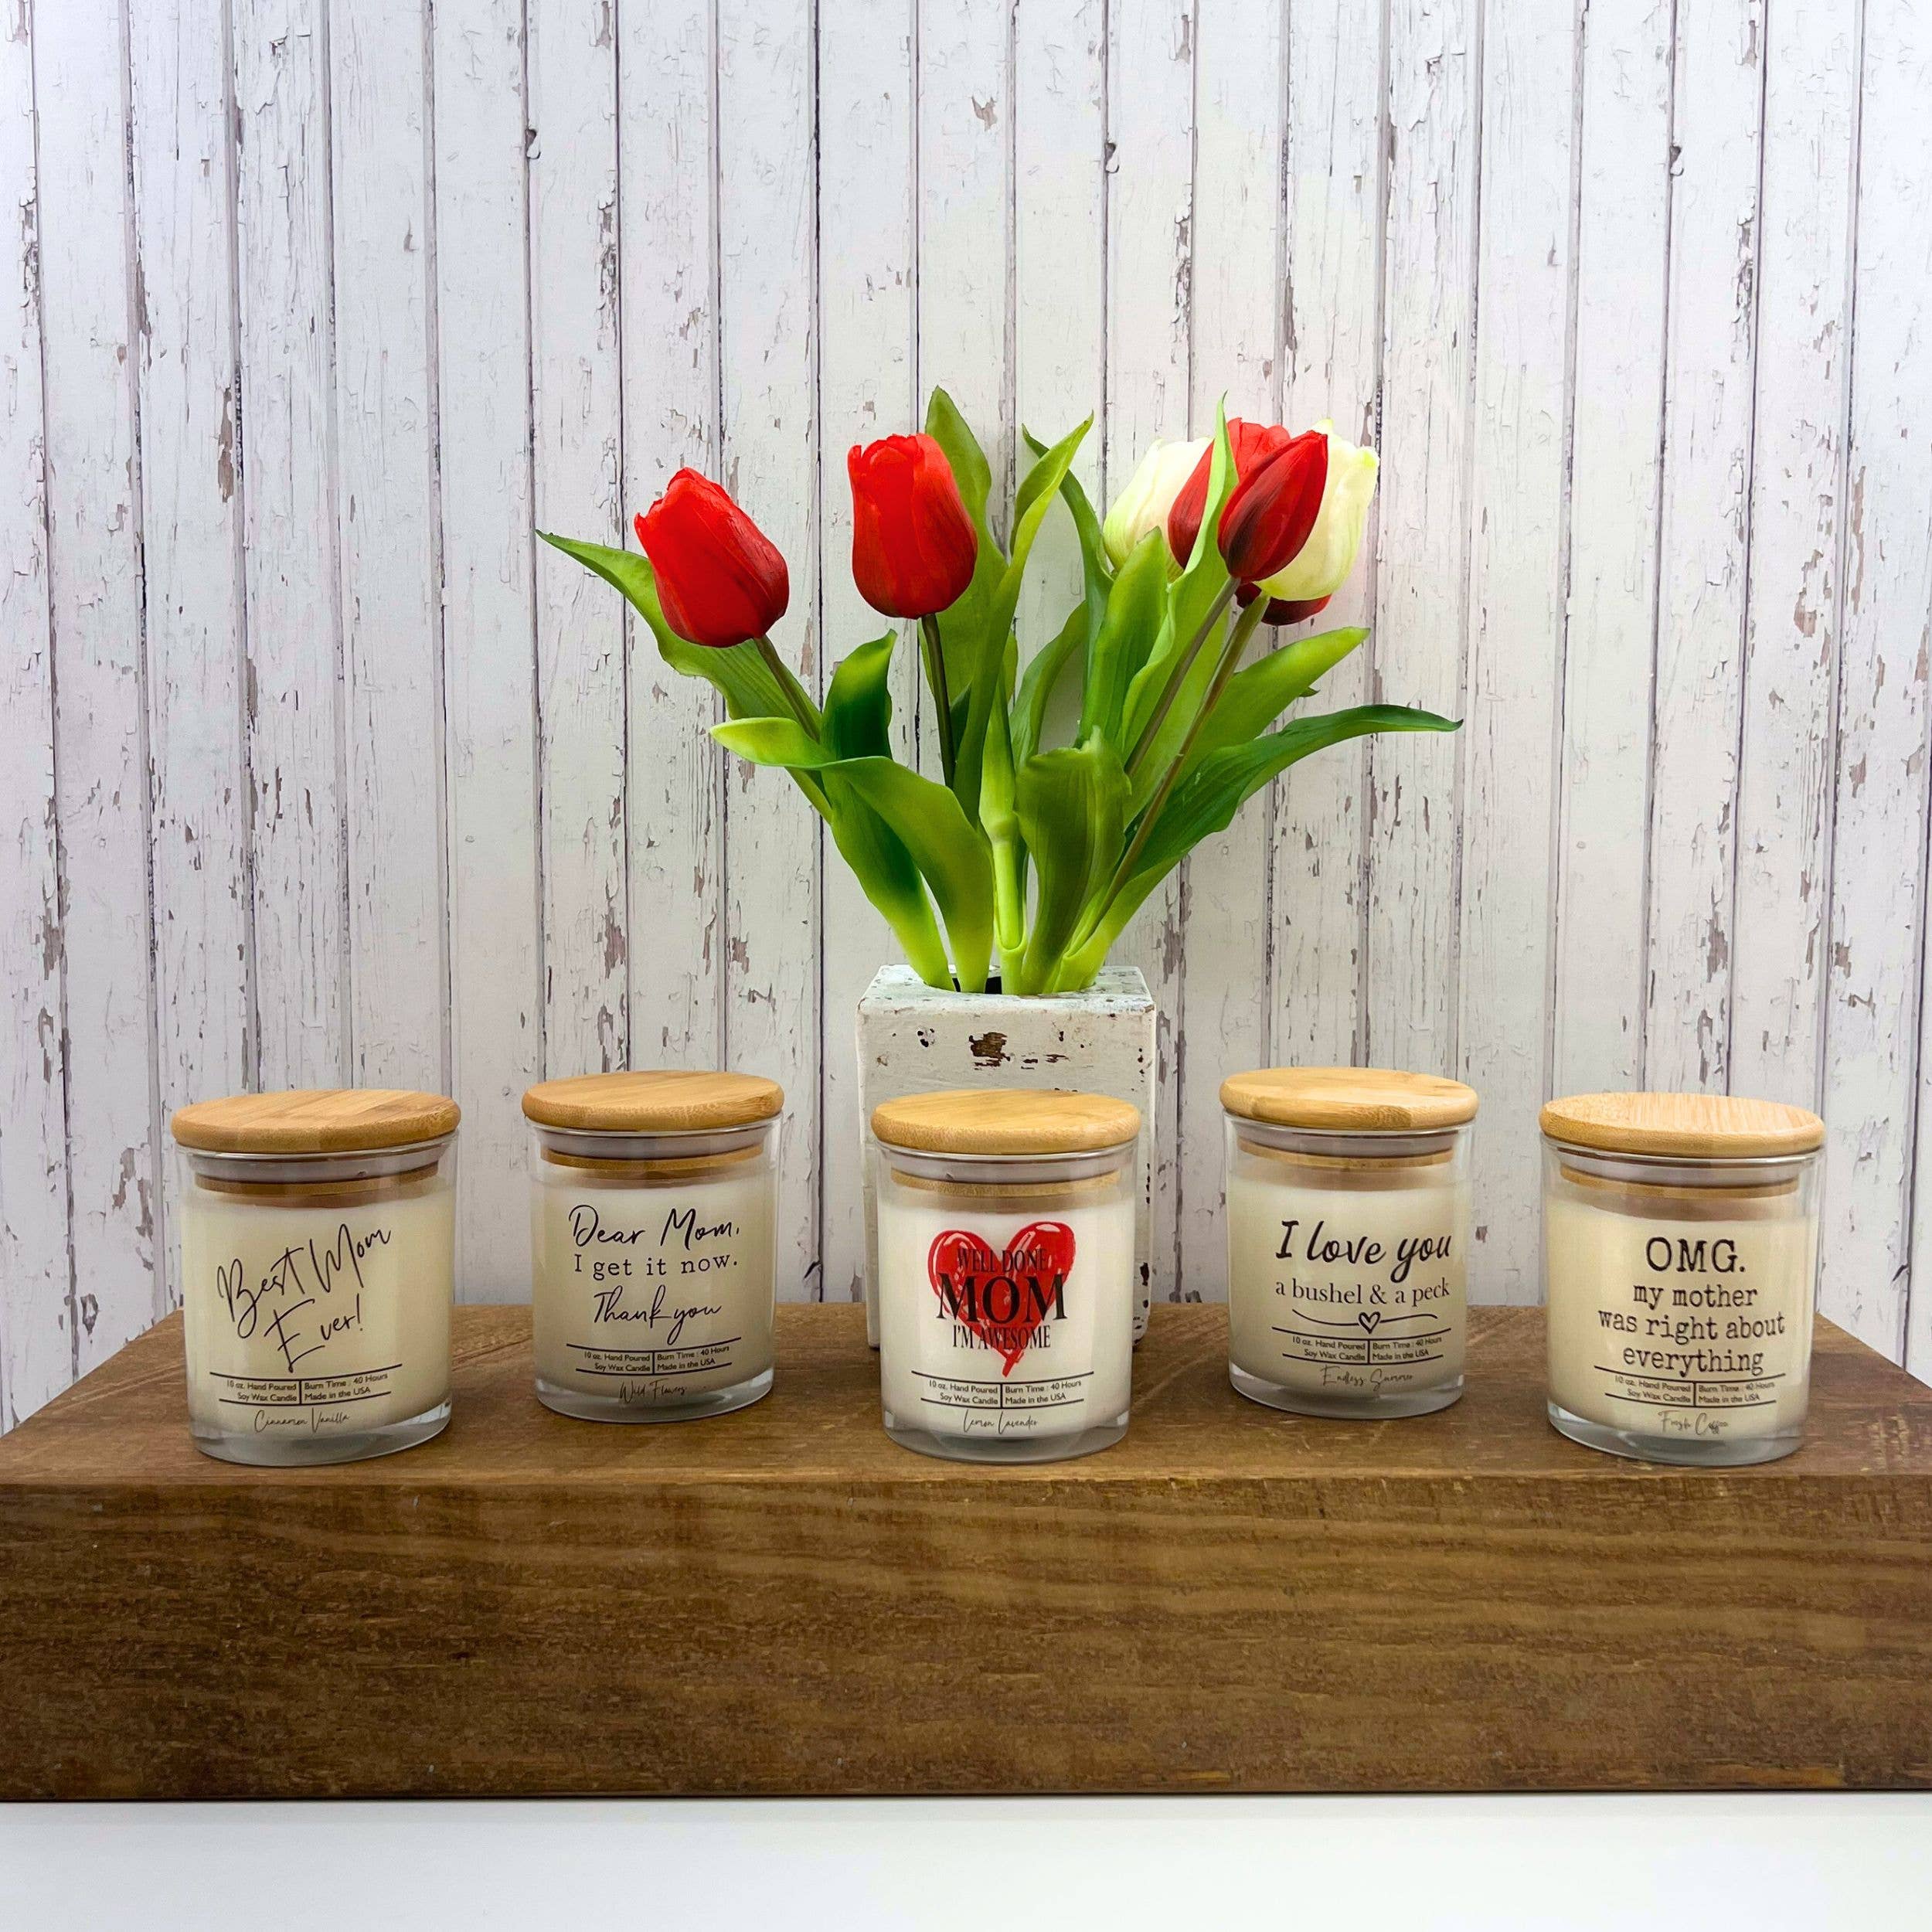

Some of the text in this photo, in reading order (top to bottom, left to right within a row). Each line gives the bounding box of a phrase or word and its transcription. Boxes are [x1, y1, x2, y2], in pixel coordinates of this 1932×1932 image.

[568, 1204, 646, 1247] Dear
[957, 1248, 1048, 1273] WELL DONE
[1275, 1219, 1452, 1283] I love you
[1645, 1236, 1746, 1273] OMG.
[574, 1253, 738, 1281] I get it now.
[217, 1224, 391, 1338] Best Mom
[1275, 1277, 1451, 1307] a bushel & a peck
[936, 1273, 1068, 1324] MOM
[1633, 1284, 1758, 1310] my mother
[594, 1284, 722, 1345] Thank you
[1597, 1310, 1785, 1345] was right about
[264, 1293, 363, 1373] Ever!
[953, 1325, 1051, 1349] I'M AWESOME
[1315, 1340, 1335, 1349] Hand
[1338, 1342, 1366, 1351] Poured
[594, 1362, 607, 1372] Soy
[1304, 1349, 1317, 1358] Soy
[1318, 1351, 1336, 1359] Wax
[1338, 1352, 1366, 1361] Candle
[1623, 1346, 1764, 1378] everything
[238, 1392, 249, 1402] Soy
[252, 1393, 267, 1402] Wax
[270, 1393, 297, 1402] Candle
[353, 1386, 371, 1395] USA
[269, 1383, 296, 1391] Poured
[304, 1382, 325, 1390] Burn
[366, 1374, 388, 1383] Hours
[929, 1379, 937, 1388] 10
[950, 1384, 968, 1393] Hand
[971, 1386, 998, 1394] Poured
[1005, 1386, 1024, 1394] Burn
[1026, 1384, 1045, 1393] Time
[1061, 1379, 1082, 1389] Hours
[1639, 1380, 1659, 1389] Hand
[1662, 1383, 1691, 1391] Poured
[940, 1393, 952, 1403] Soy
[954, 1395, 971, 1403] Wax
[1028, 1395, 1035, 1403] in
[1036, 1394, 1049, 1403] the
[1050, 1393, 1066, 1401] USA
[1662, 1393, 1691, 1403] Candle
[1722, 1394, 1729, 1403] in
